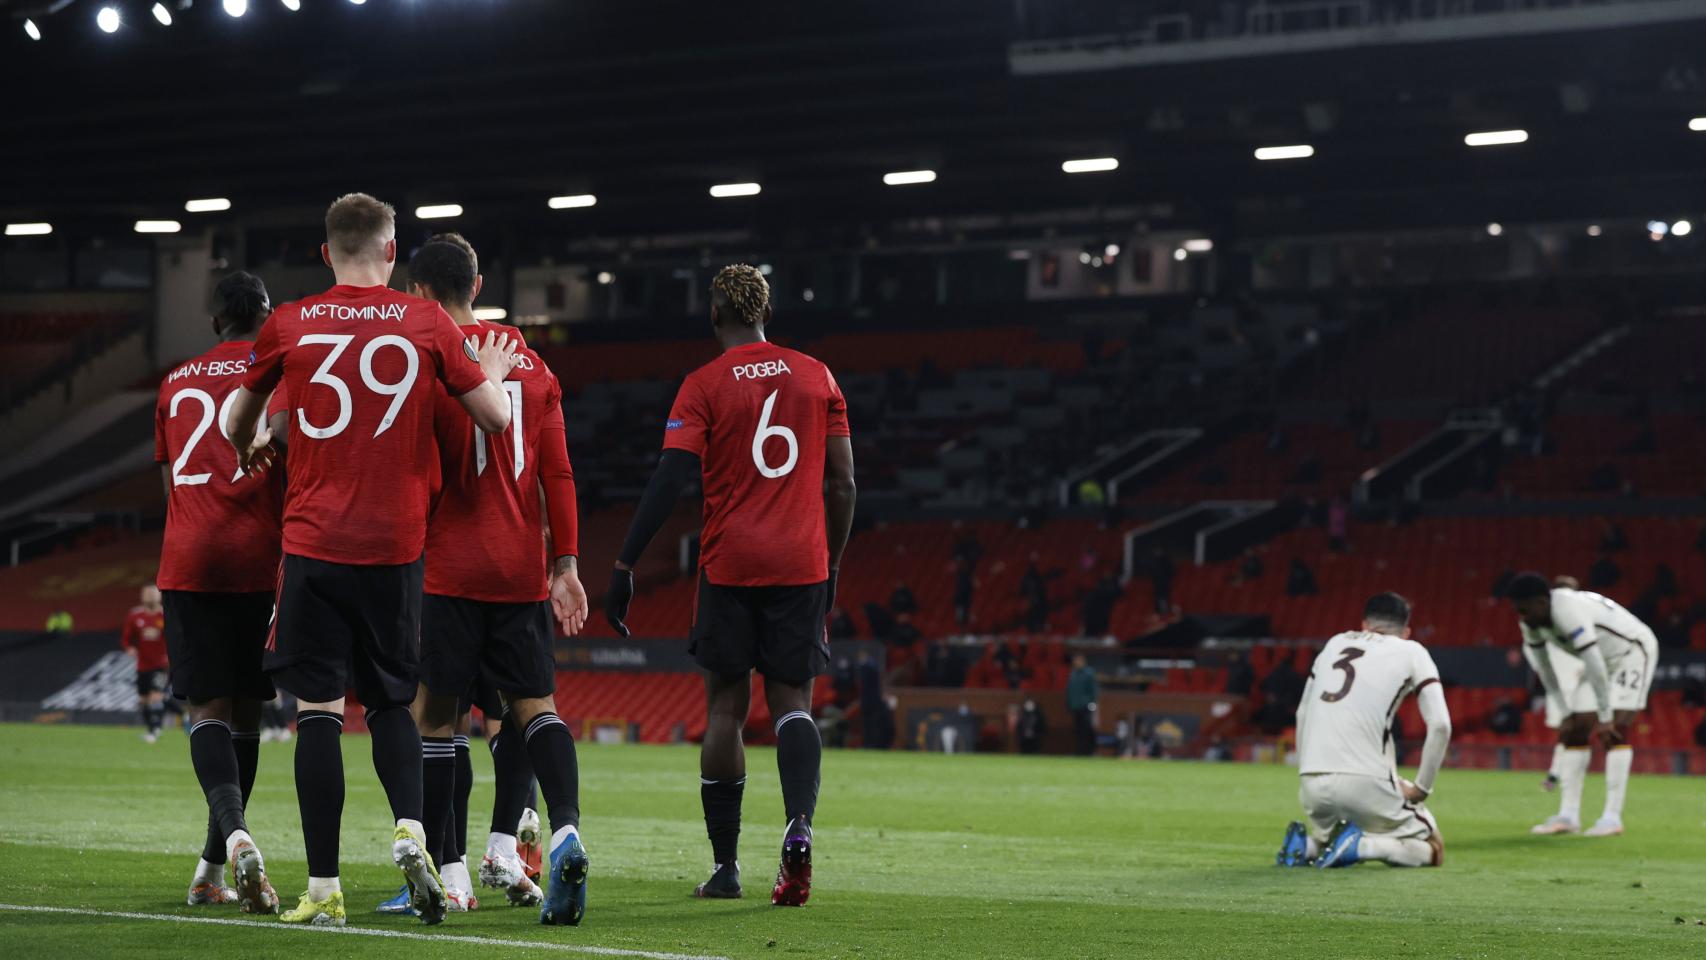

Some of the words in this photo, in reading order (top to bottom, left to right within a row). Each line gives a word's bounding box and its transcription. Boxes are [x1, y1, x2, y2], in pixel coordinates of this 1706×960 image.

[168, 360, 247, 384] WAN-BISS
[296, 333, 420, 440] 39
[732, 359, 791, 381] POGBA
[752, 388, 799, 479] 6
[1320, 646, 1365, 702] 3
[1616, 669, 1641, 689] 42
